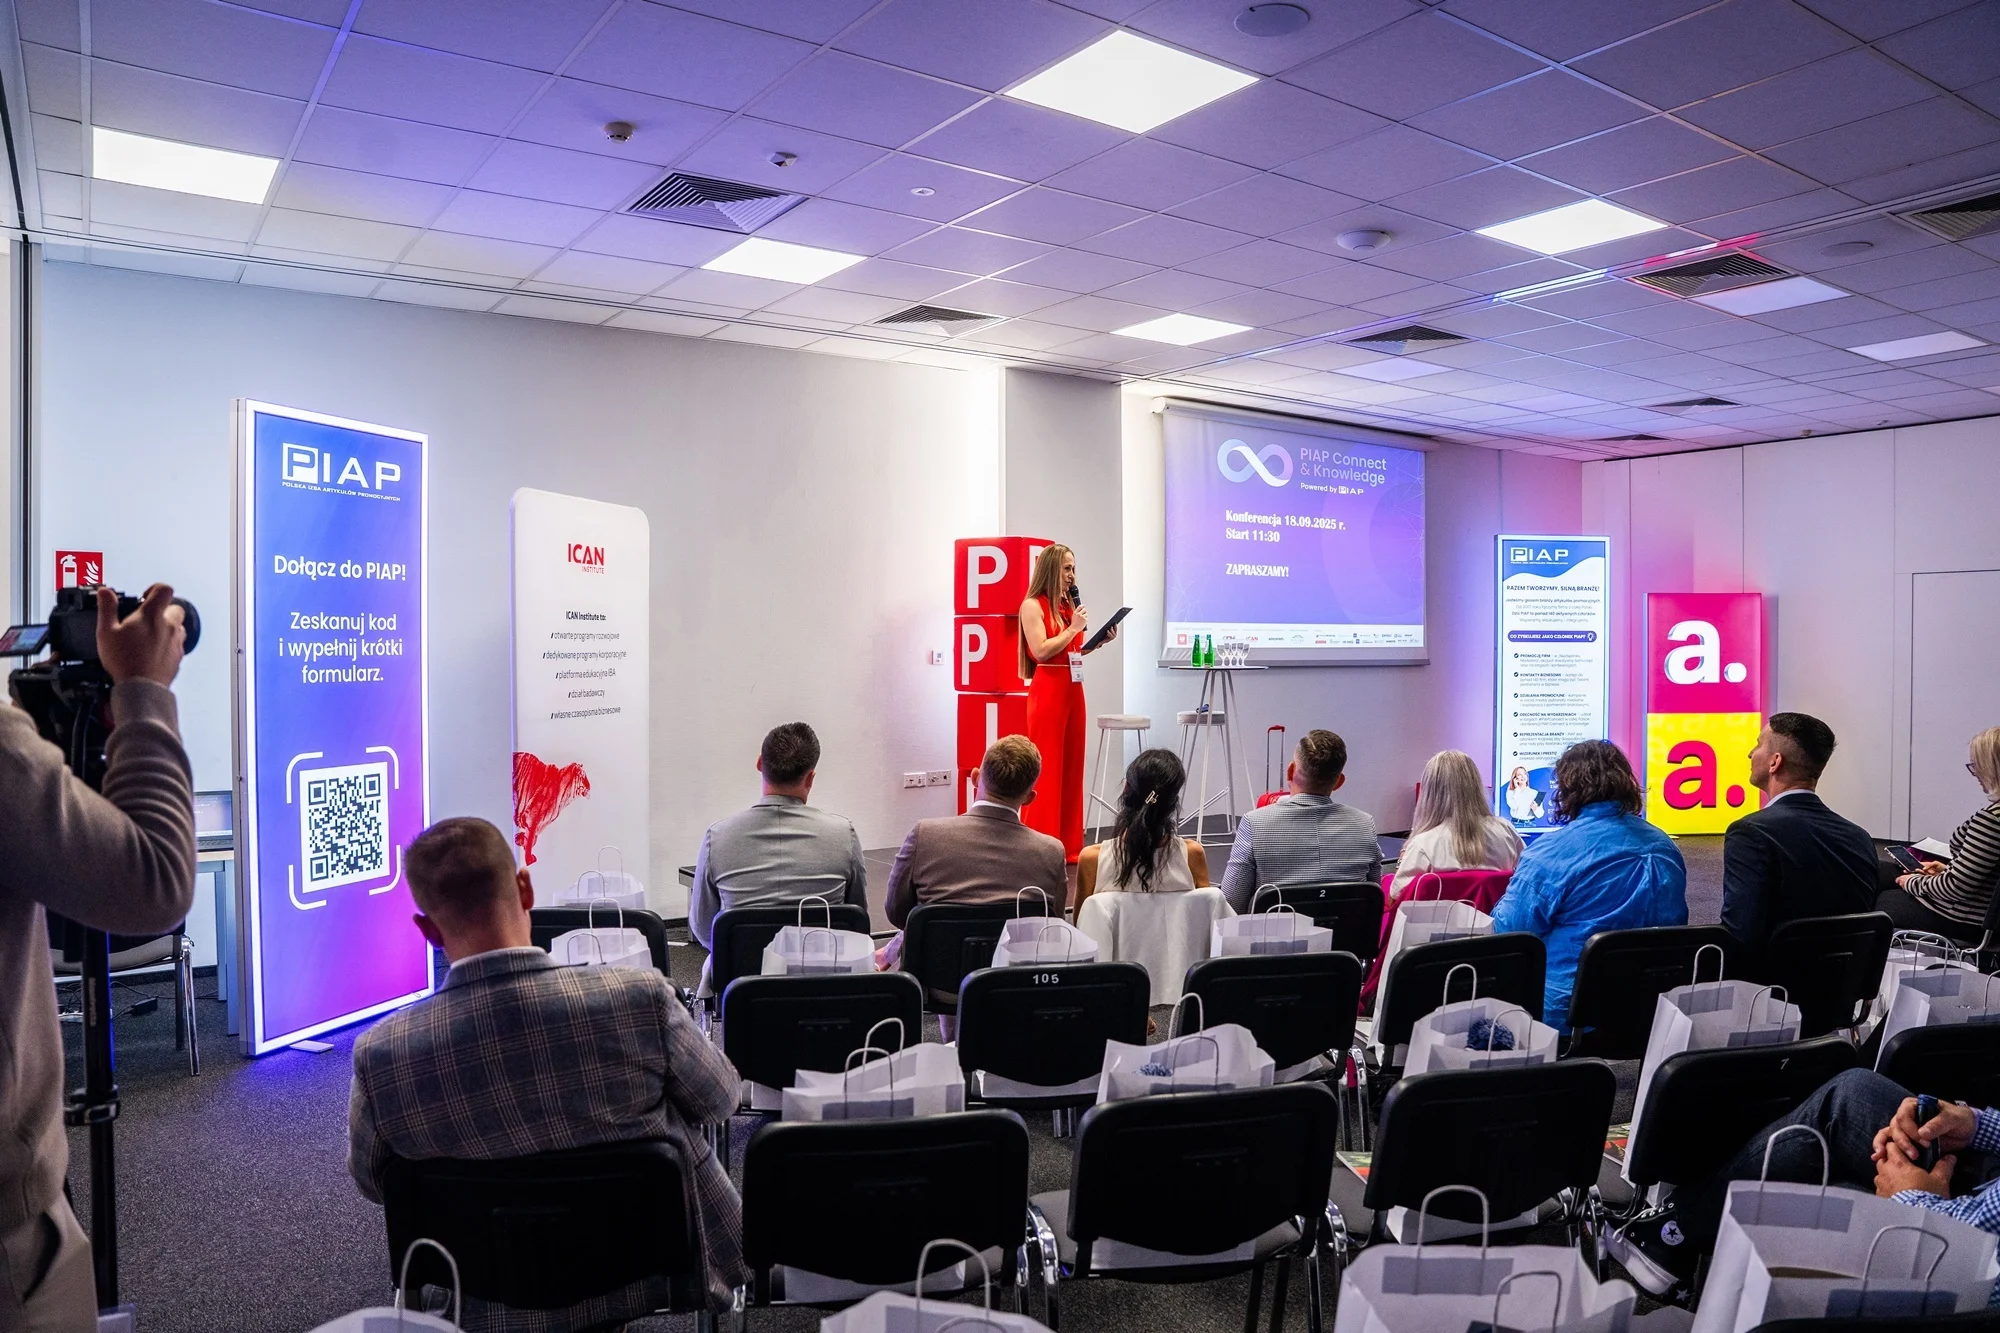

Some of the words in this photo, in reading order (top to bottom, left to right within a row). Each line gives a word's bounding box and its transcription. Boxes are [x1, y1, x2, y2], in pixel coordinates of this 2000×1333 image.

[282, 442, 401, 490] PIAP
[1300, 448, 1330, 462] PIAP
[1332, 452, 1387, 471] Connect
[1300, 462, 1310, 476] &
[1314, 464, 1385, 488] Knowledge
[282, 482, 306, 490] POLSKA
[358, 492, 401, 501] PROMOCYJNYCH
[1300, 482, 1328, 492] Powered
[1330, 485, 1337, 494] by
[1338, 486, 1364, 494] PIAP
[1225, 510, 1282, 527] Konferencja
[1284, 515, 1336, 530] 18.09.2025
[1338, 521, 1346, 530] r.
[1225, 528, 1250, 540] Start
[1252, 530, 1280, 542] 11:30
[568, 542, 604, 566] ICAN
[1511, 547, 1568, 561] PIAP
[274, 555, 336, 580] Dołącz
[340, 560, 362, 578] do
[366, 562, 406, 581] PIAP!
[582, 566, 604, 574] INSTITUTE
[966, 546, 1008, 608] P
[1226, 563, 1289, 577] ZAPRASZAMY!
[290, 612, 365, 636] Zeskanuj
[369, 613, 396, 630] kod
[566, 611, 578, 620] ICAN
[579, 612, 599, 620] Institute
[574, 632, 595, 642] programy
[596, 632, 620, 641] rozwojowe
[279, 638, 284, 656] i
[288, 638, 356, 662] wypełnij
[361, 638, 403, 656] krótki
[546, 650, 576, 660] dedykowane
[577, 652, 598, 661] programy
[599, 650, 627, 660] korporacyjne
[962, 624, 988, 686] P
[1664, 620, 1748, 685] a.
[302, 664, 384, 683] formularz.
[559, 670, 582, 681] platforma
[583, 669, 608, 679] edukacyjna
[571, 689, 582, 698] dział
[583, 689, 605, 698] badawczy
[554, 710, 571, 719] własne
[572, 708, 598, 718] czasopisma
[598, 707, 621, 716] biznesowe
[1663, 740, 1745, 810] a.
[1033, 973, 1059, 984] 105
[1780, 1058, 1789, 1070] 7
